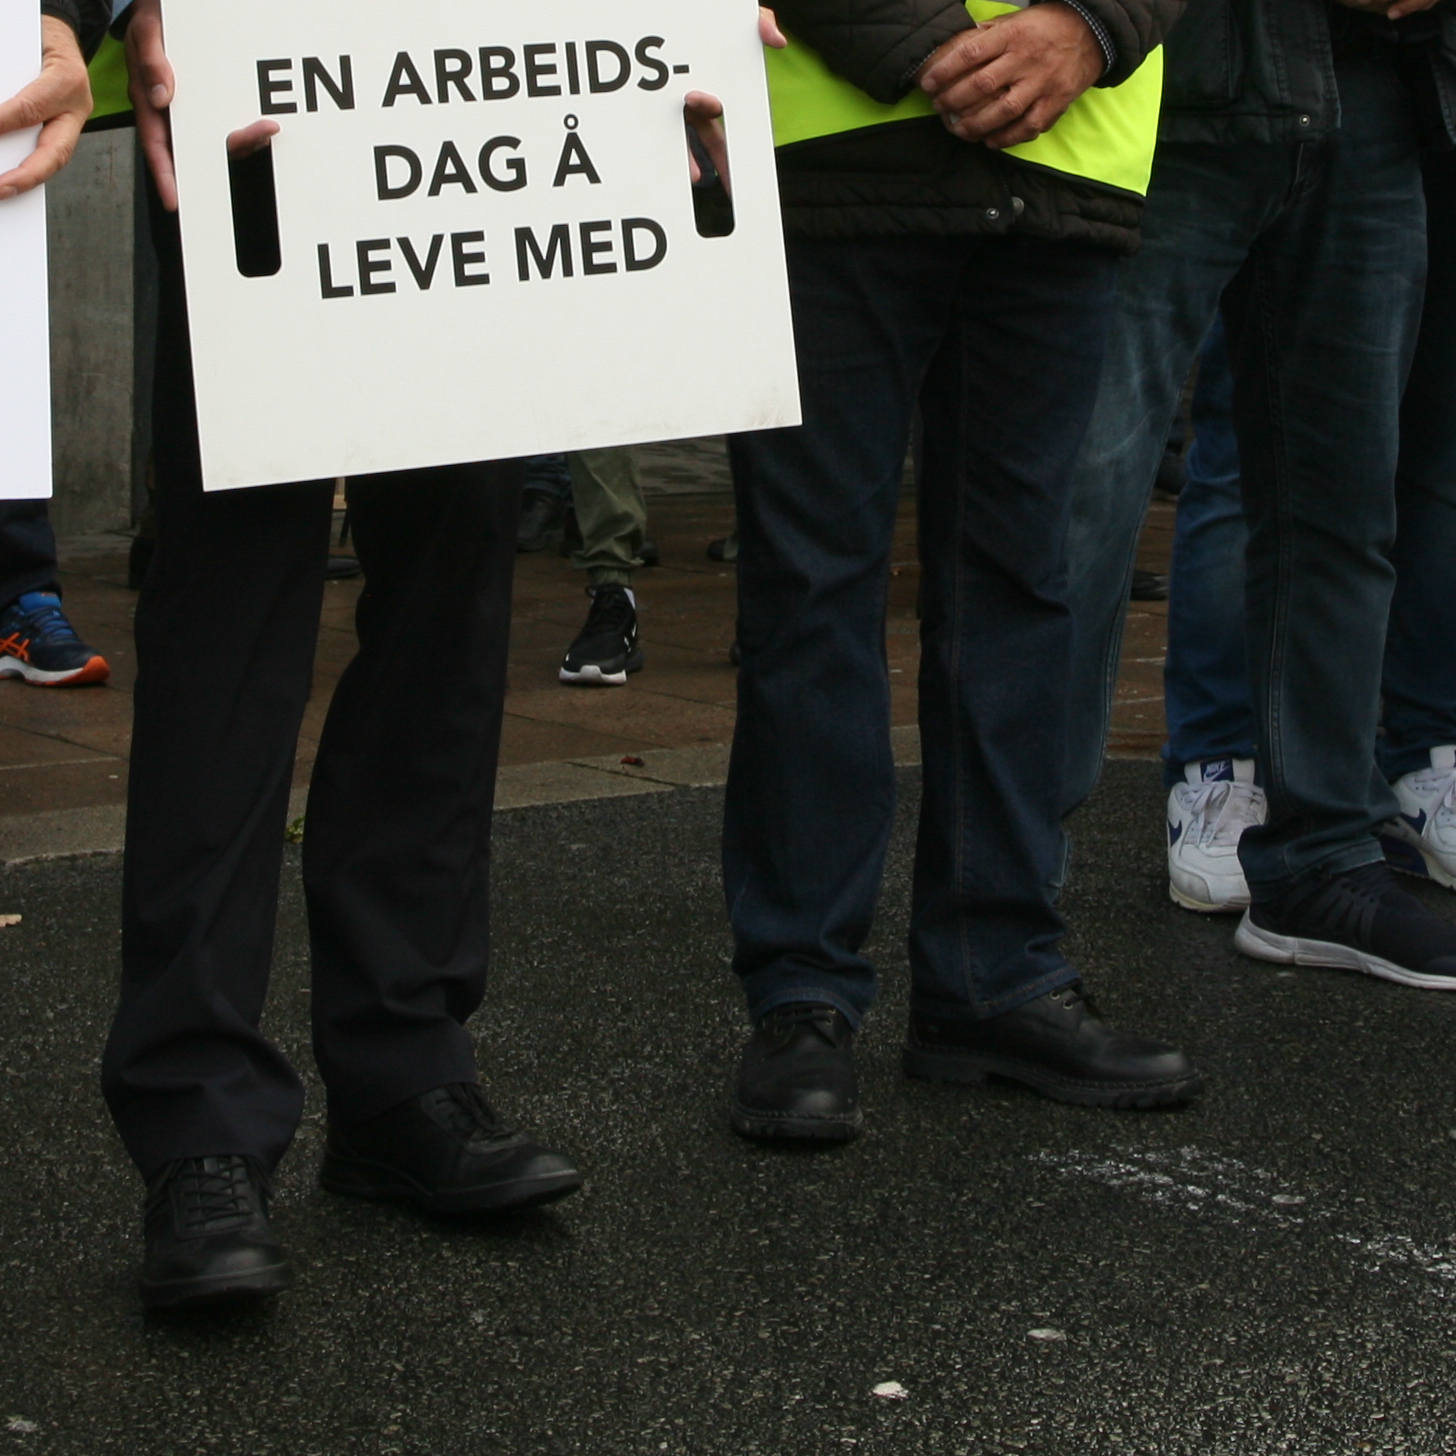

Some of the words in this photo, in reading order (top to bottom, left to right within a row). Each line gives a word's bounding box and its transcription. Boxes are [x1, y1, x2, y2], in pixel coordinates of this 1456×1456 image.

[256, 55, 356, 116] EN
[382, 36, 691, 109] ARBEIDS-
[373, 135, 528, 202] DAG
[553, 114, 603, 188] Å
[317, 230, 491, 299] LEVE
[514, 217, 668, 282] MED
